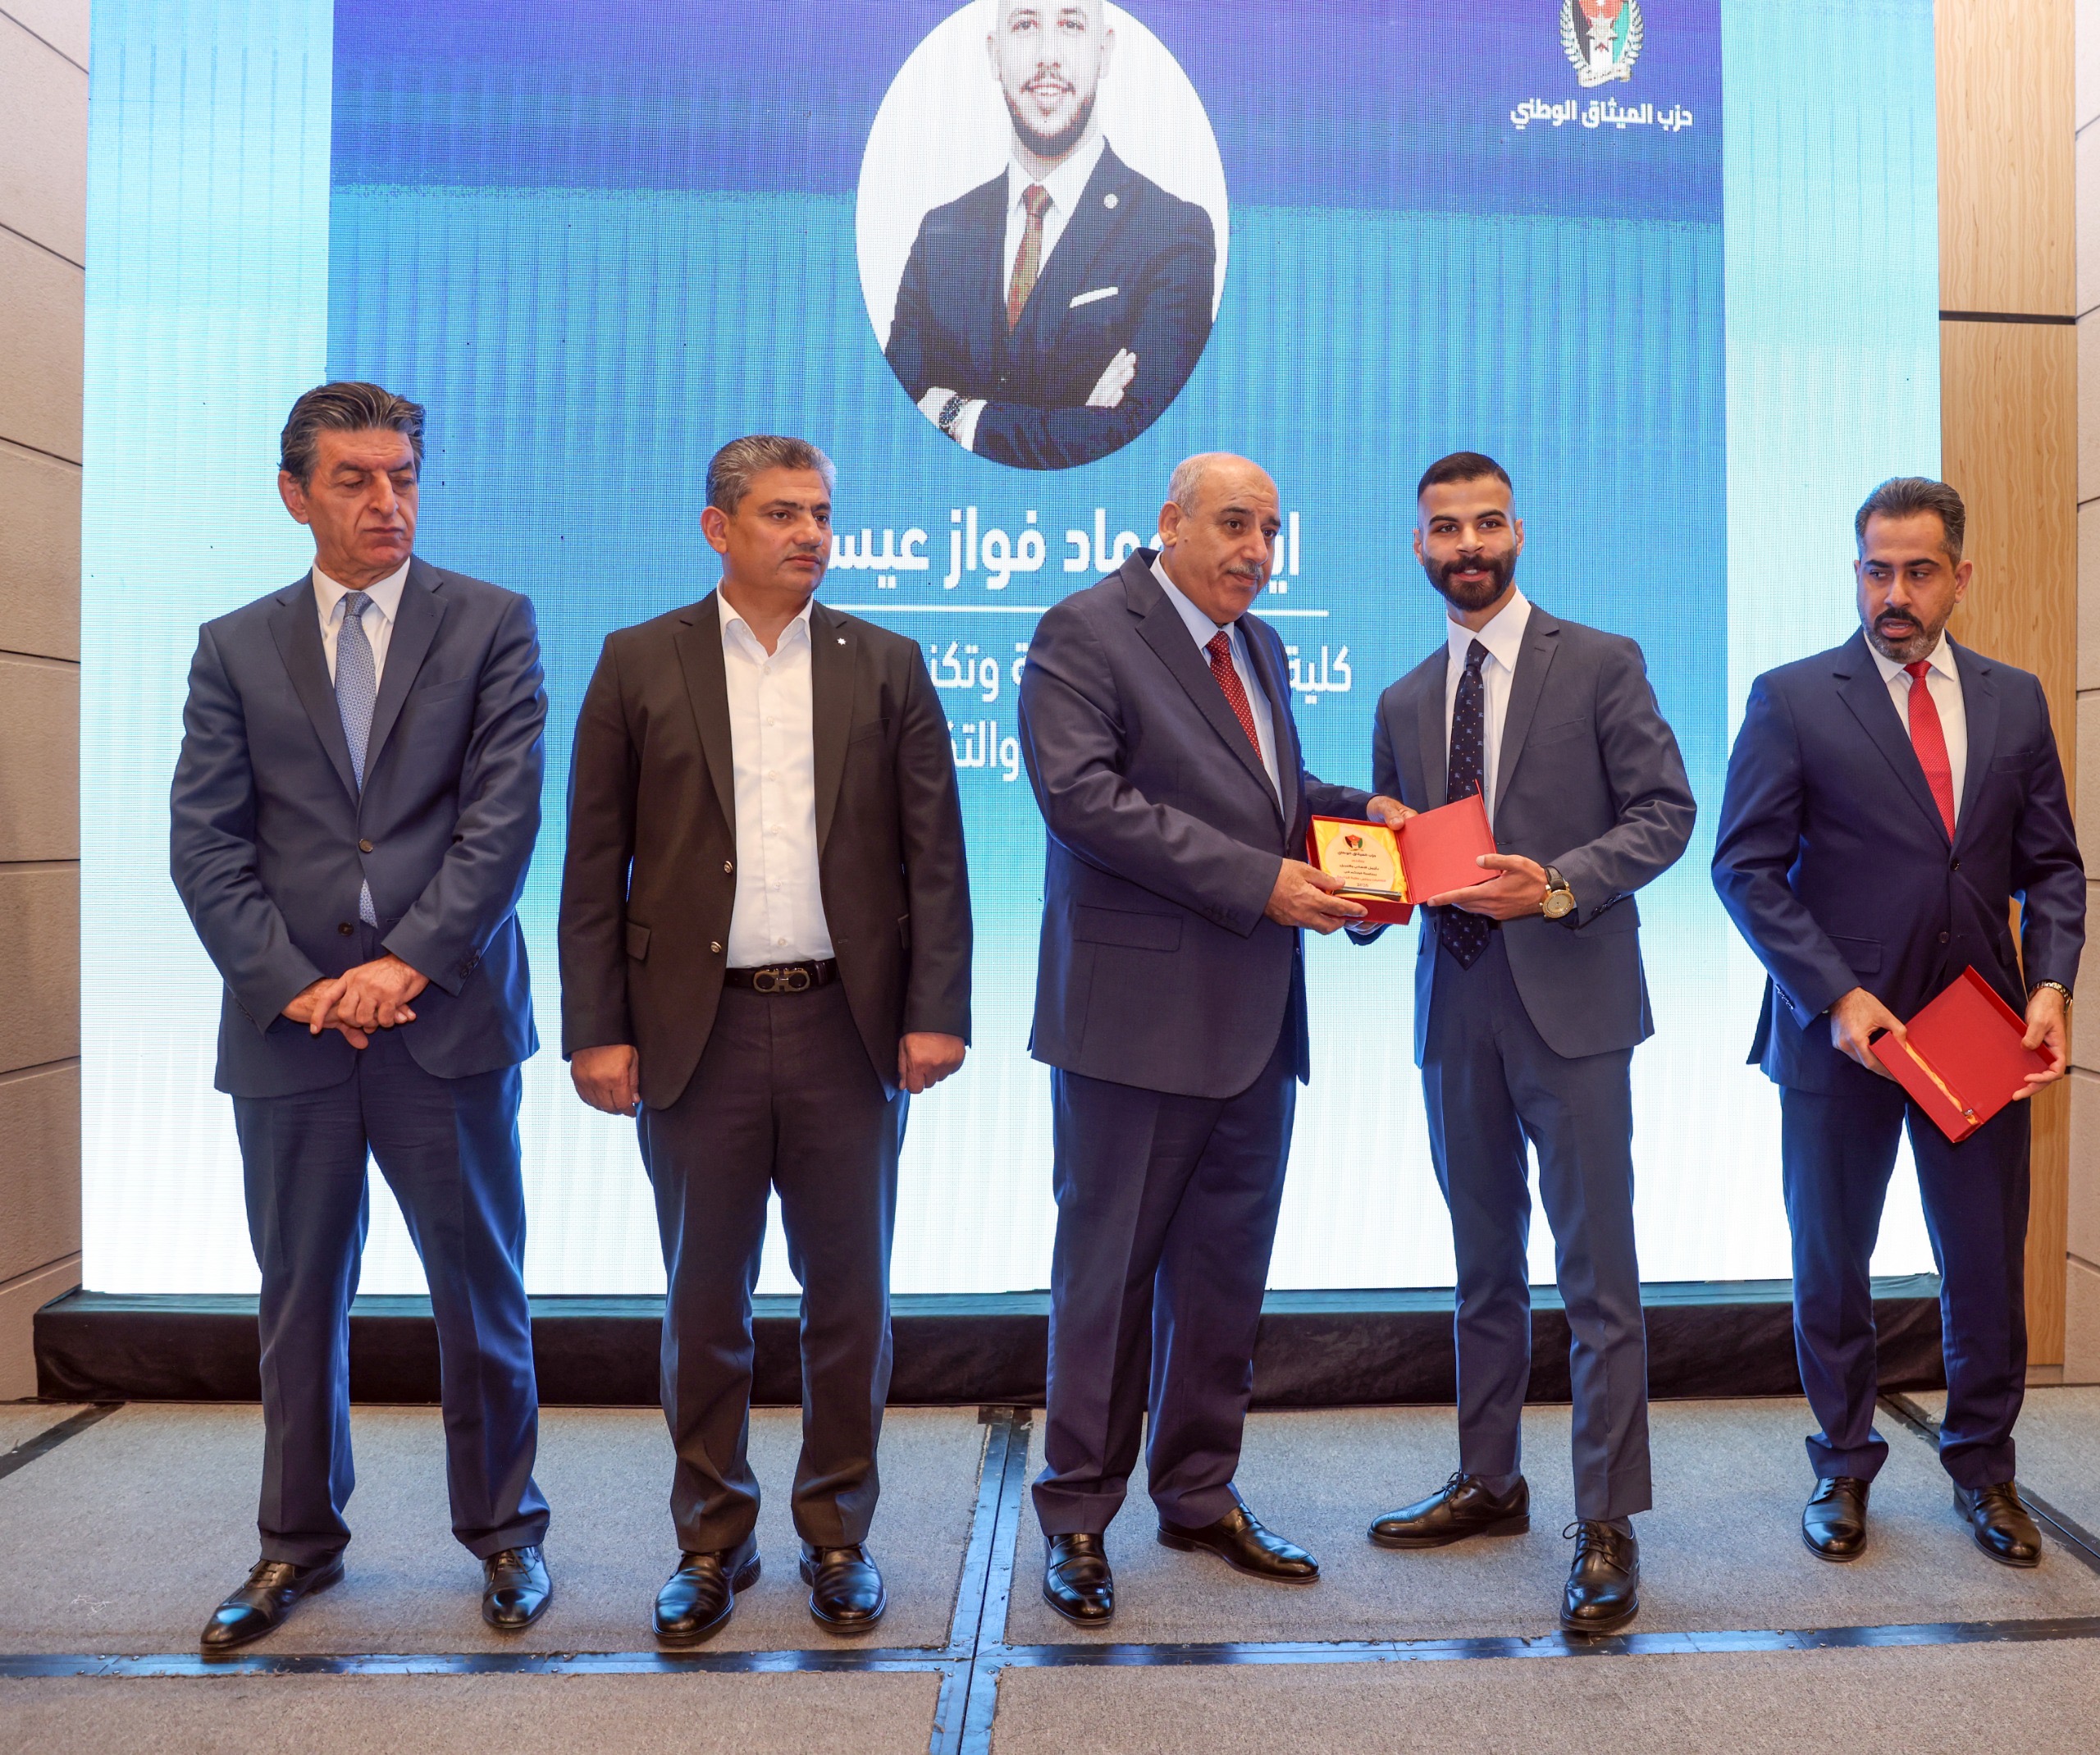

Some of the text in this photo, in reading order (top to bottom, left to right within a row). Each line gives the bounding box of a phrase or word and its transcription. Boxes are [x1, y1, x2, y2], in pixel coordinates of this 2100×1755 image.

[1510, 97, 1693, 132] حزب الميثاق الوطني
[828, 528, 929, 589] عيس
[943, 505, 1045, 590] فواز
[930, 641, 999, 702] وتكن
[1285, 644, 1353, 705] كلية
